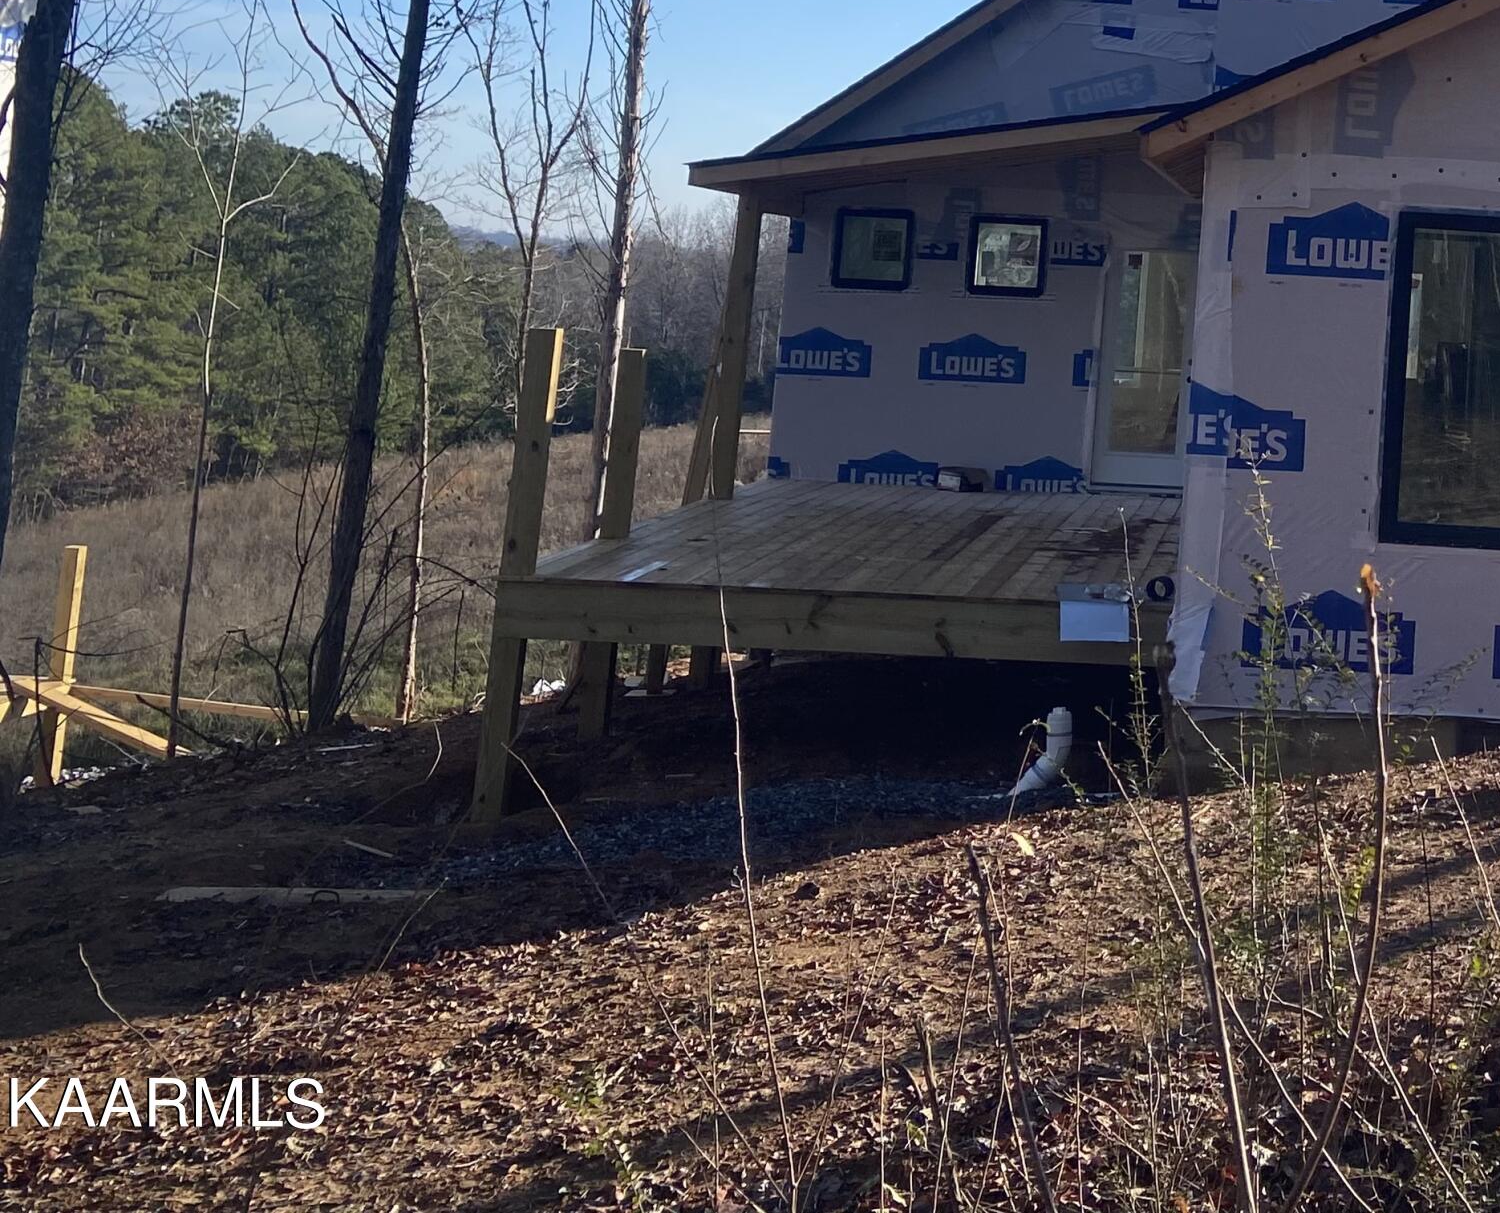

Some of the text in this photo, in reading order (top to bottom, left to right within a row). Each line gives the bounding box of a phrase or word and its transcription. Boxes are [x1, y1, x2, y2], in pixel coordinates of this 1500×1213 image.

[1286, 229, 1391, 271] LOWE
[776, 345, 860, 373] LOWE'S
[930, 350, 1016, 379] LOWE'S
